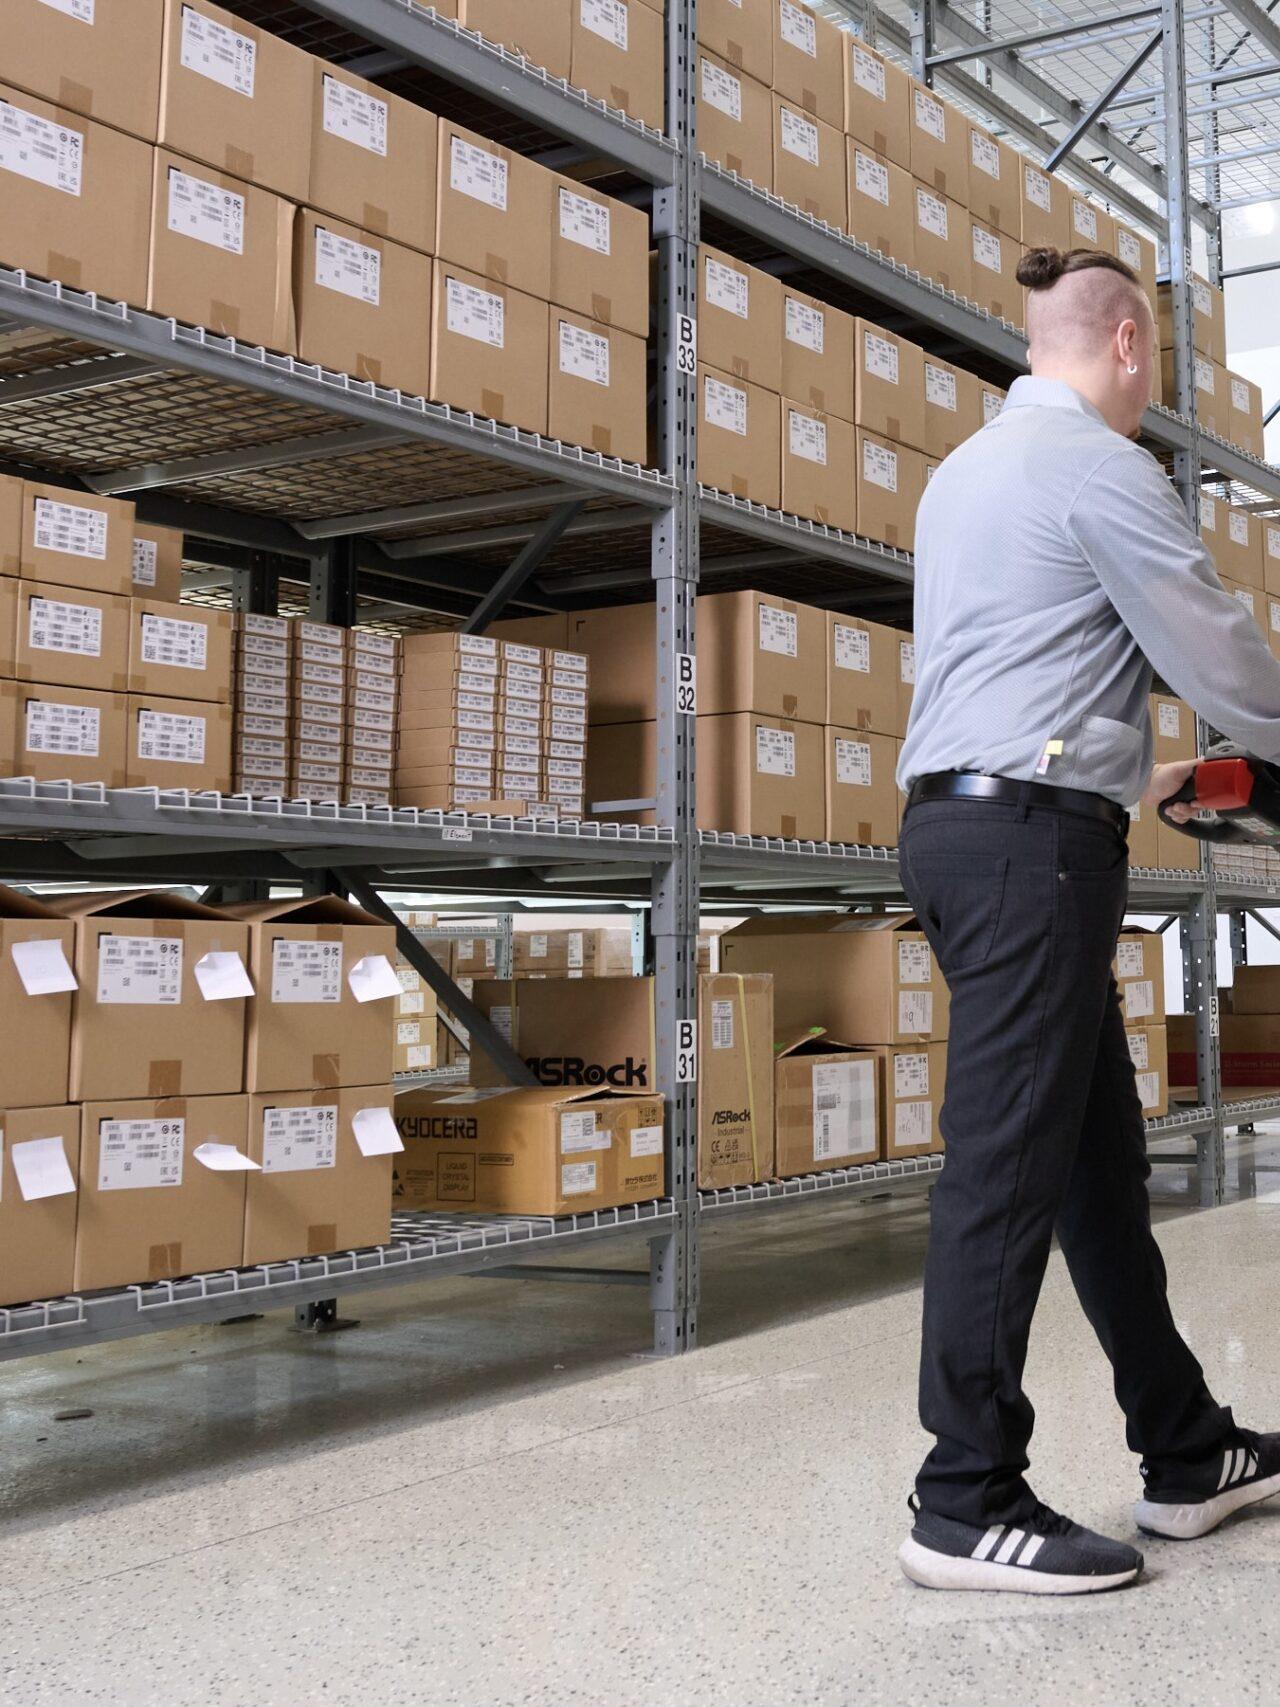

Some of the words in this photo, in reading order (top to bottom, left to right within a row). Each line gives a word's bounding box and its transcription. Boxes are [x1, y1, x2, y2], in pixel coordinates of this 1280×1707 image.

[681, 316, 693, 343] B
[678, 344, 695, 372] 33
[680, 656, 692, 682] B
[678, 685, 695, 712] 32
[1211, 998, 1217, 1015] B
[680, 1022, 693, 1049] B
[679, 1053, 695, 1079] 31
[711, 1108, 751, 1125] ASRock
